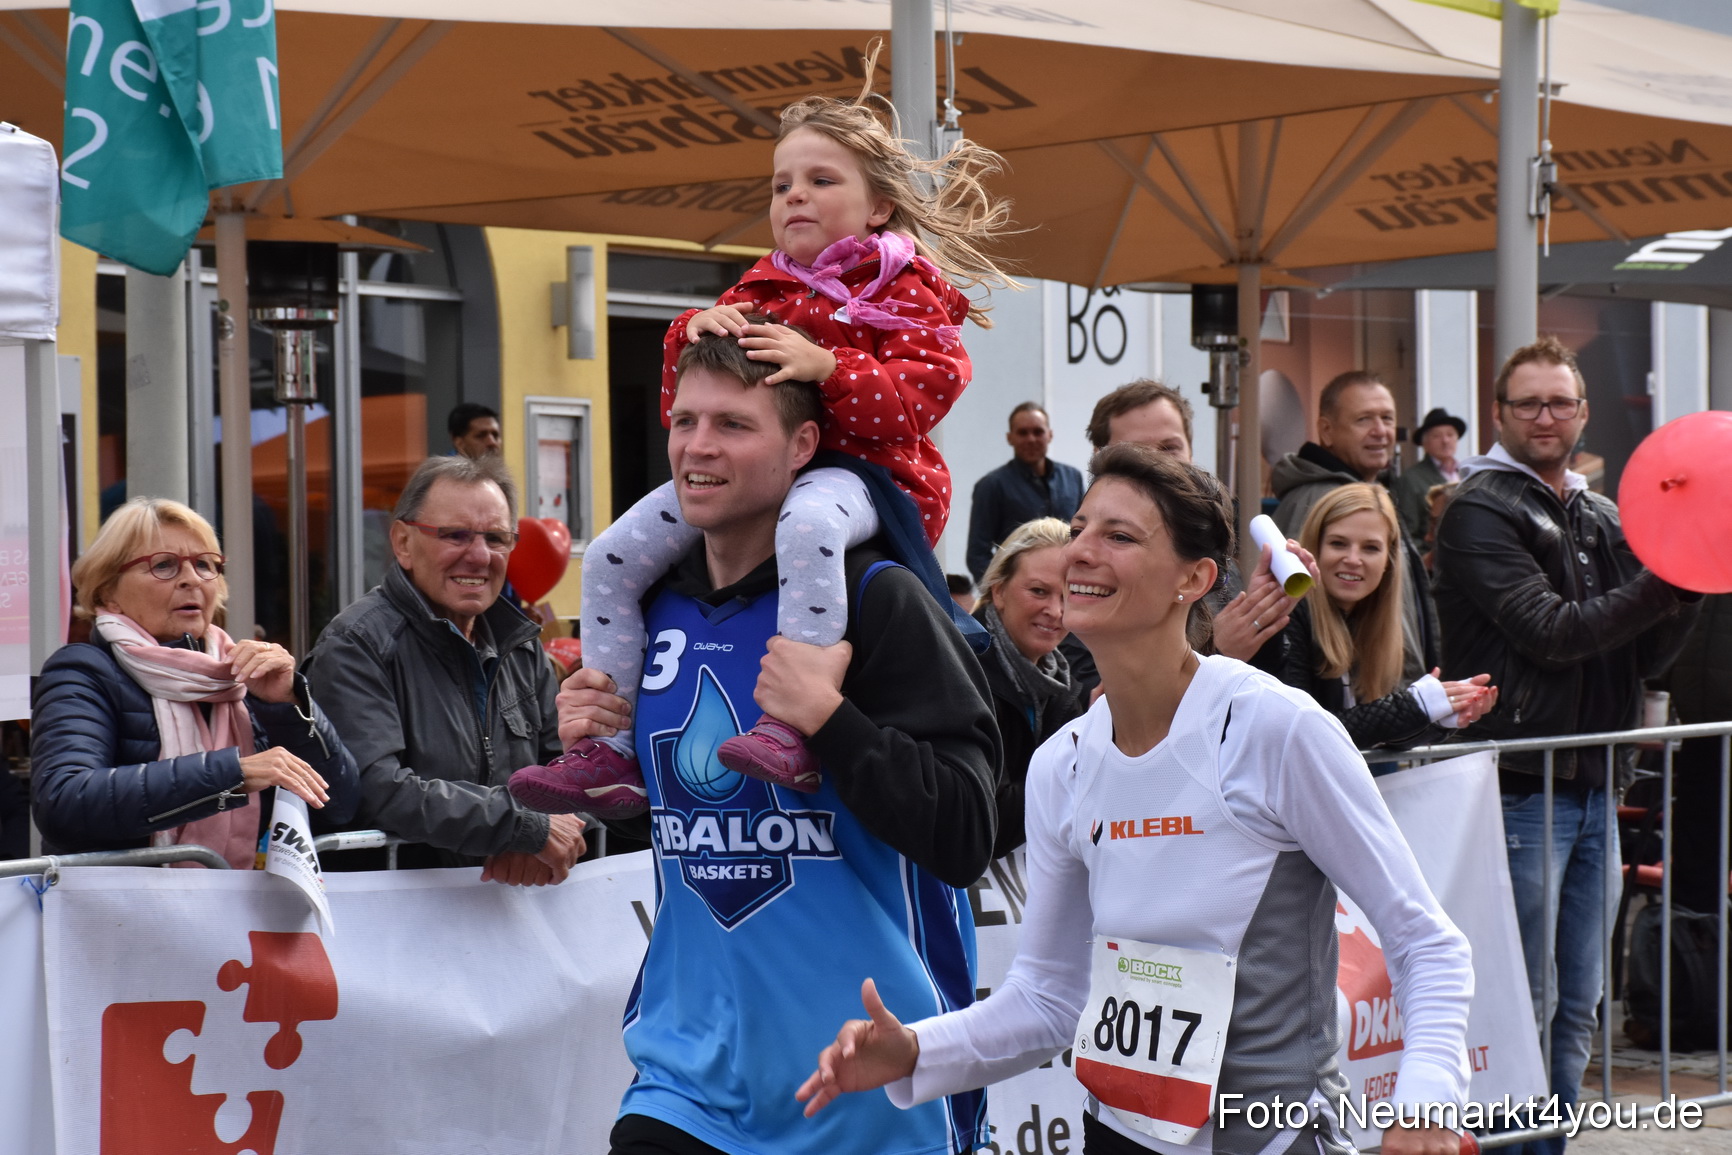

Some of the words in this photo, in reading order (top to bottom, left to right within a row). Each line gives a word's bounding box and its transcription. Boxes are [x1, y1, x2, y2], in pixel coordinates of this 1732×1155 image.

[1110, 816, 1204, 840] KLEBL
[689, 864, 773, 880] BASKETS
[1131, 959, 1183, 982] BOCK
[1094, 996, 1202, 1066] 8017
